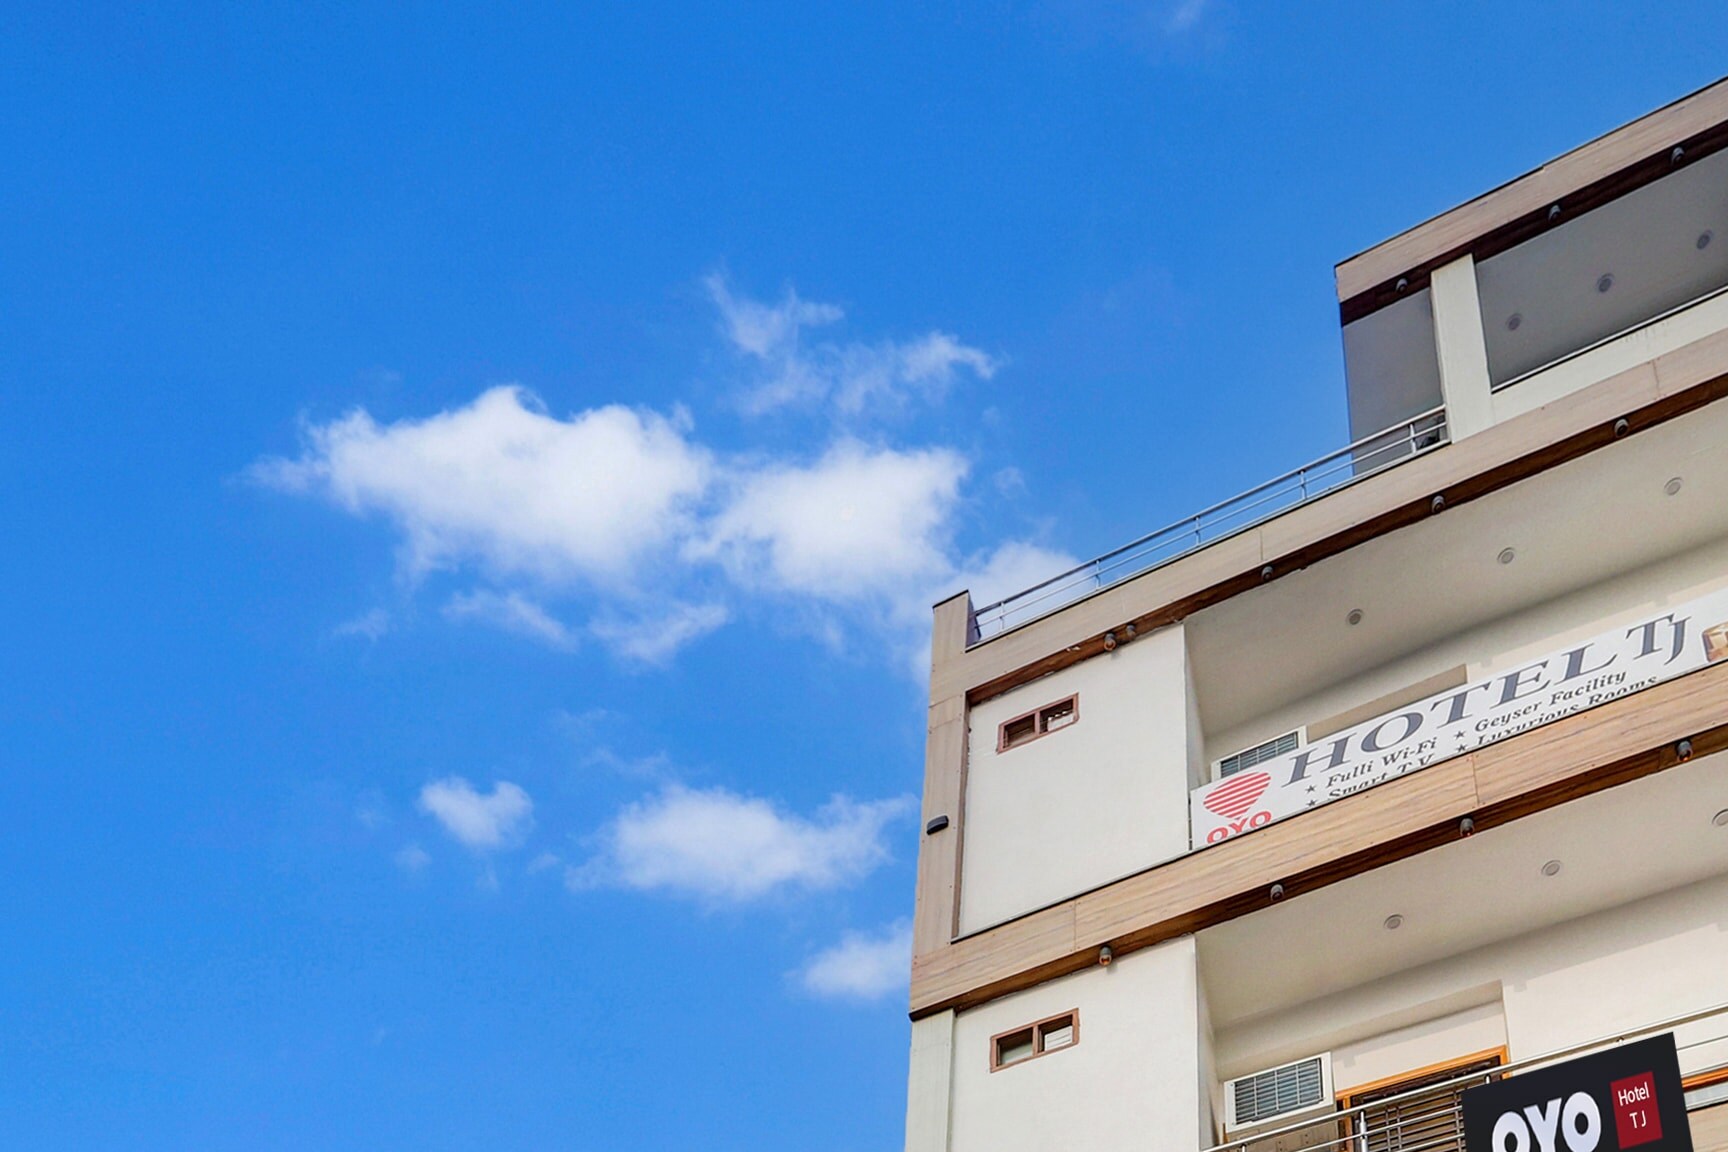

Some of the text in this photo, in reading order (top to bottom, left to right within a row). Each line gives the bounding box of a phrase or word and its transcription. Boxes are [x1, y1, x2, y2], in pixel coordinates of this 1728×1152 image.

[1281, 613, 1692, 788] HOTEL TJ
[1475, 671, 1627, 732] Geyser Facility
[1477, 675, 1658, 746] Luxurious Rooms
[1325, 737, 1437, 789] Fulli Wi-Fi
[1328, 771, 1388, 798] Smart
[1206, 811, 1272, 845] OYO
[1617, 1082, 1650, 1107] Hotel
